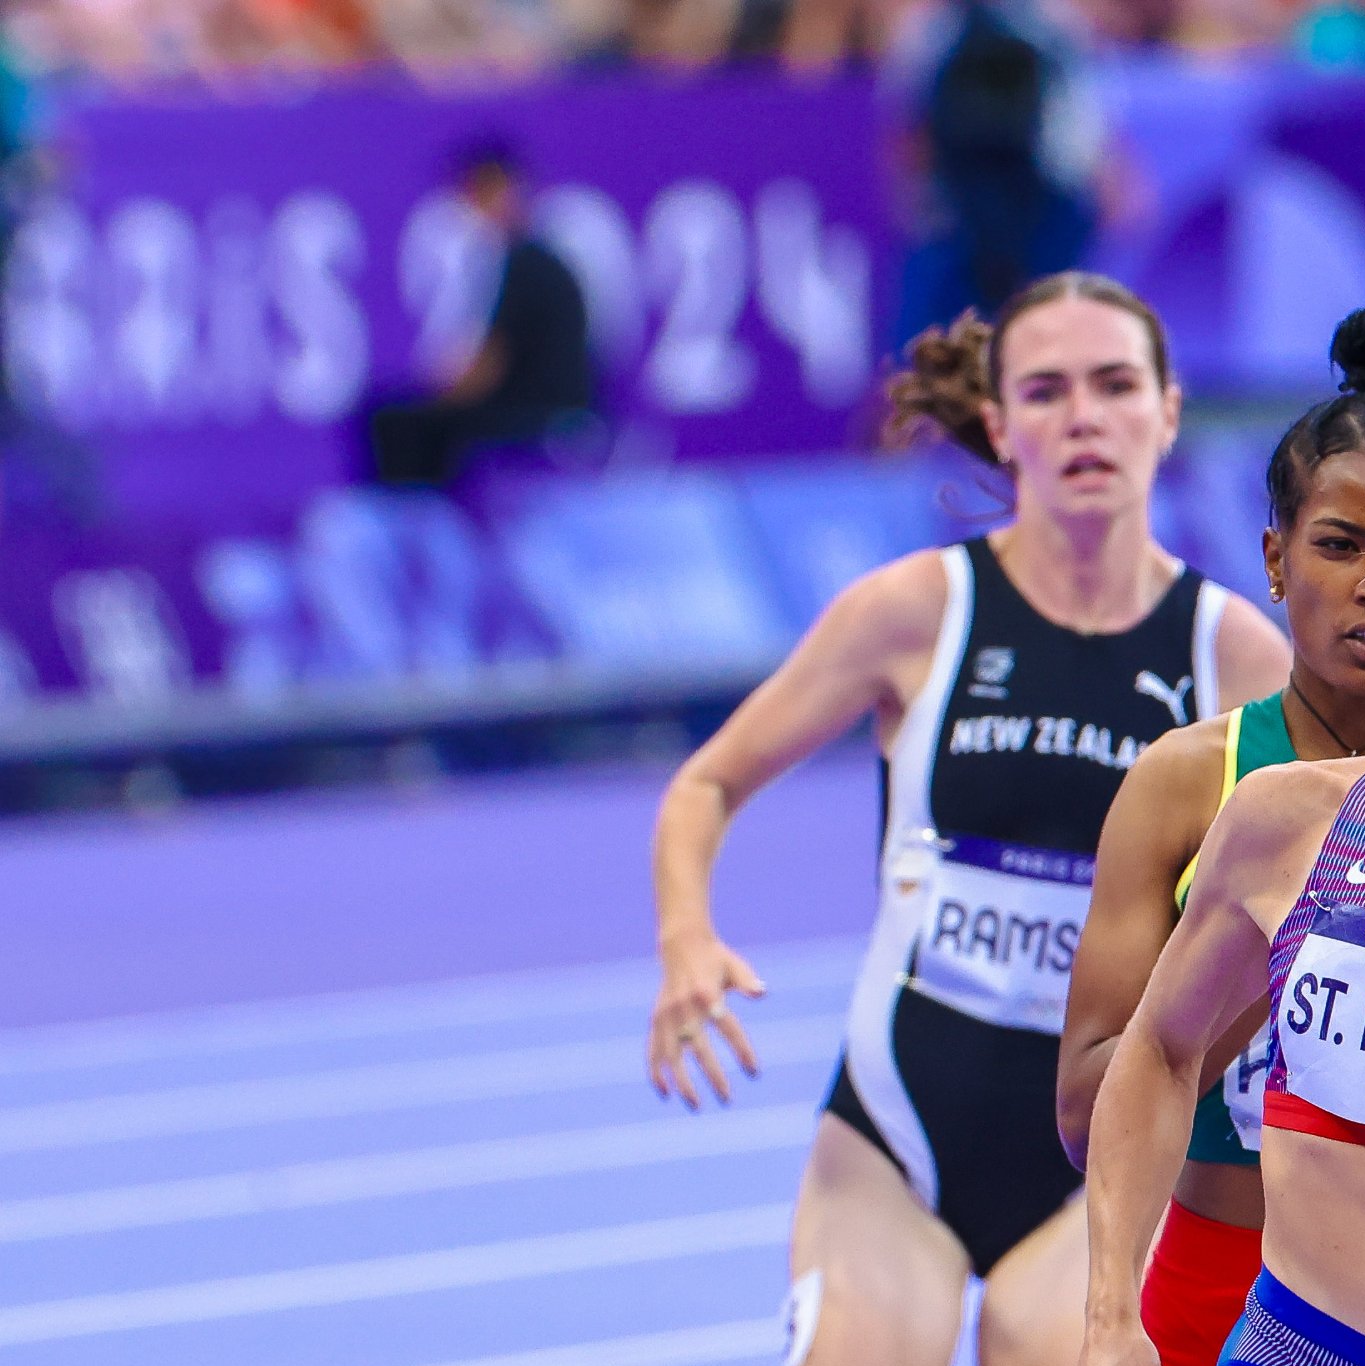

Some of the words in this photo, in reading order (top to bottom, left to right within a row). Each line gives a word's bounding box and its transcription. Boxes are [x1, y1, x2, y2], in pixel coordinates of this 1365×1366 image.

[950, 715, 1032, 755] NEW
[1033, 716, 1150, 770] ZEALA
[1287, 972, 1349, 1045] ST.
